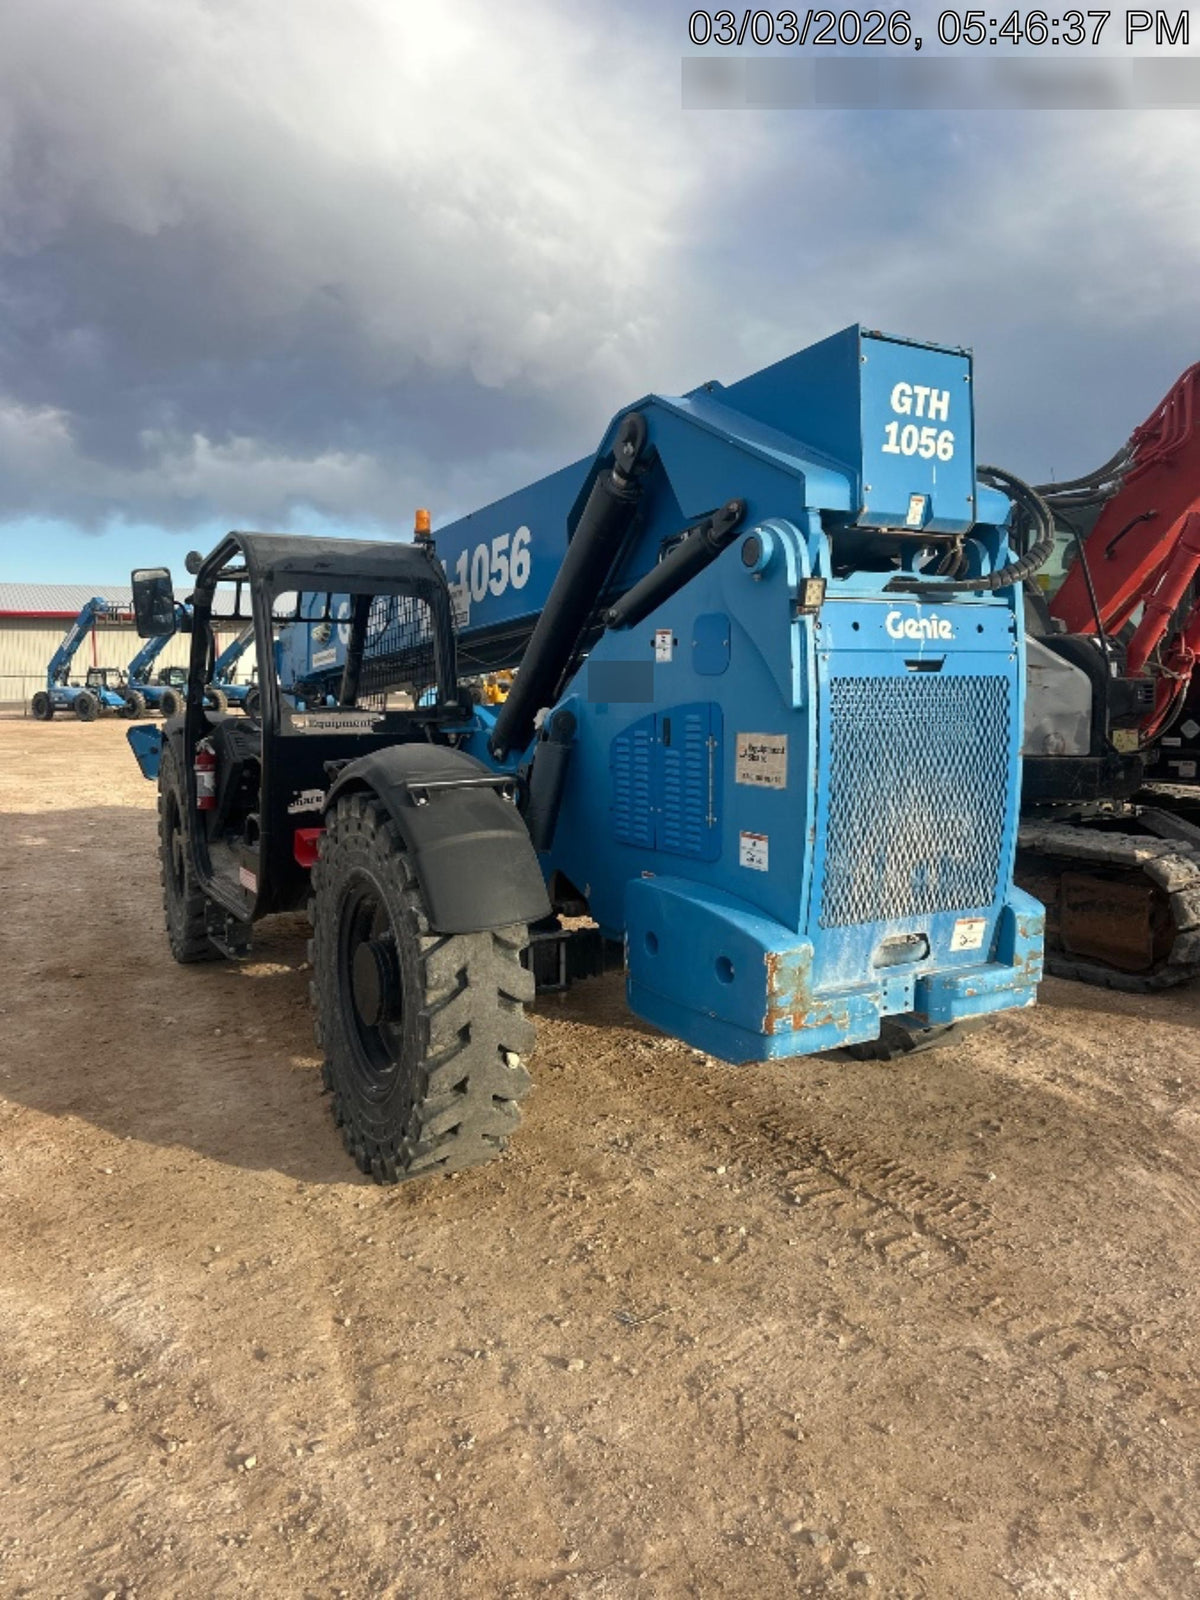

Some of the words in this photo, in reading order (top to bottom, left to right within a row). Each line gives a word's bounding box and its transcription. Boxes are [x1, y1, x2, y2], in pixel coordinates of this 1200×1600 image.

[891, 381, 950, 422] GTH
[881, 421, 955, 462] 1056
[885, 611, 955, 640] Genie
